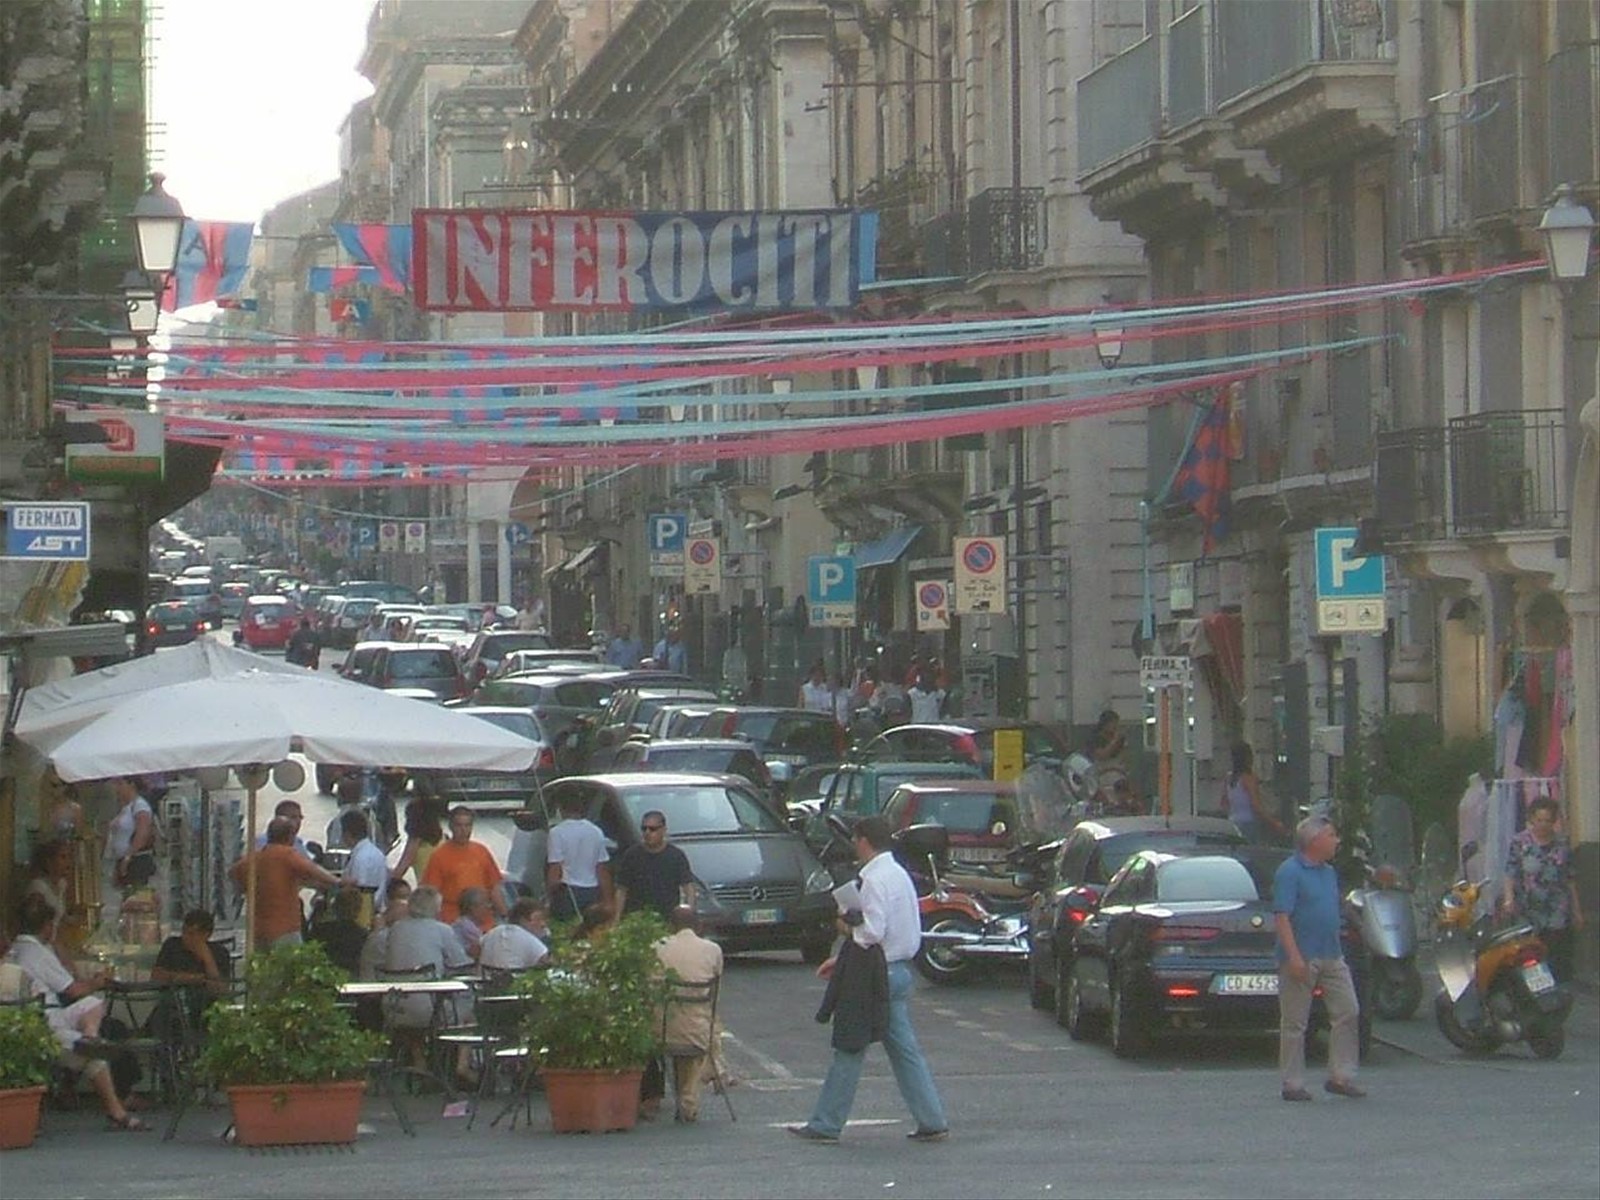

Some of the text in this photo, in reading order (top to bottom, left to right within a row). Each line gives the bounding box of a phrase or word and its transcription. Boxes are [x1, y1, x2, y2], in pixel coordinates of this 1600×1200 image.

[425, 212, 855, 308] INFEROCITI
[18, 510, 78, 528] FERMATA
[360, 527, 371, 542] P
[656, 518, 679, 548] P
[1331, 538, 1367, 588] P
[819, 563, 845, 596] P
